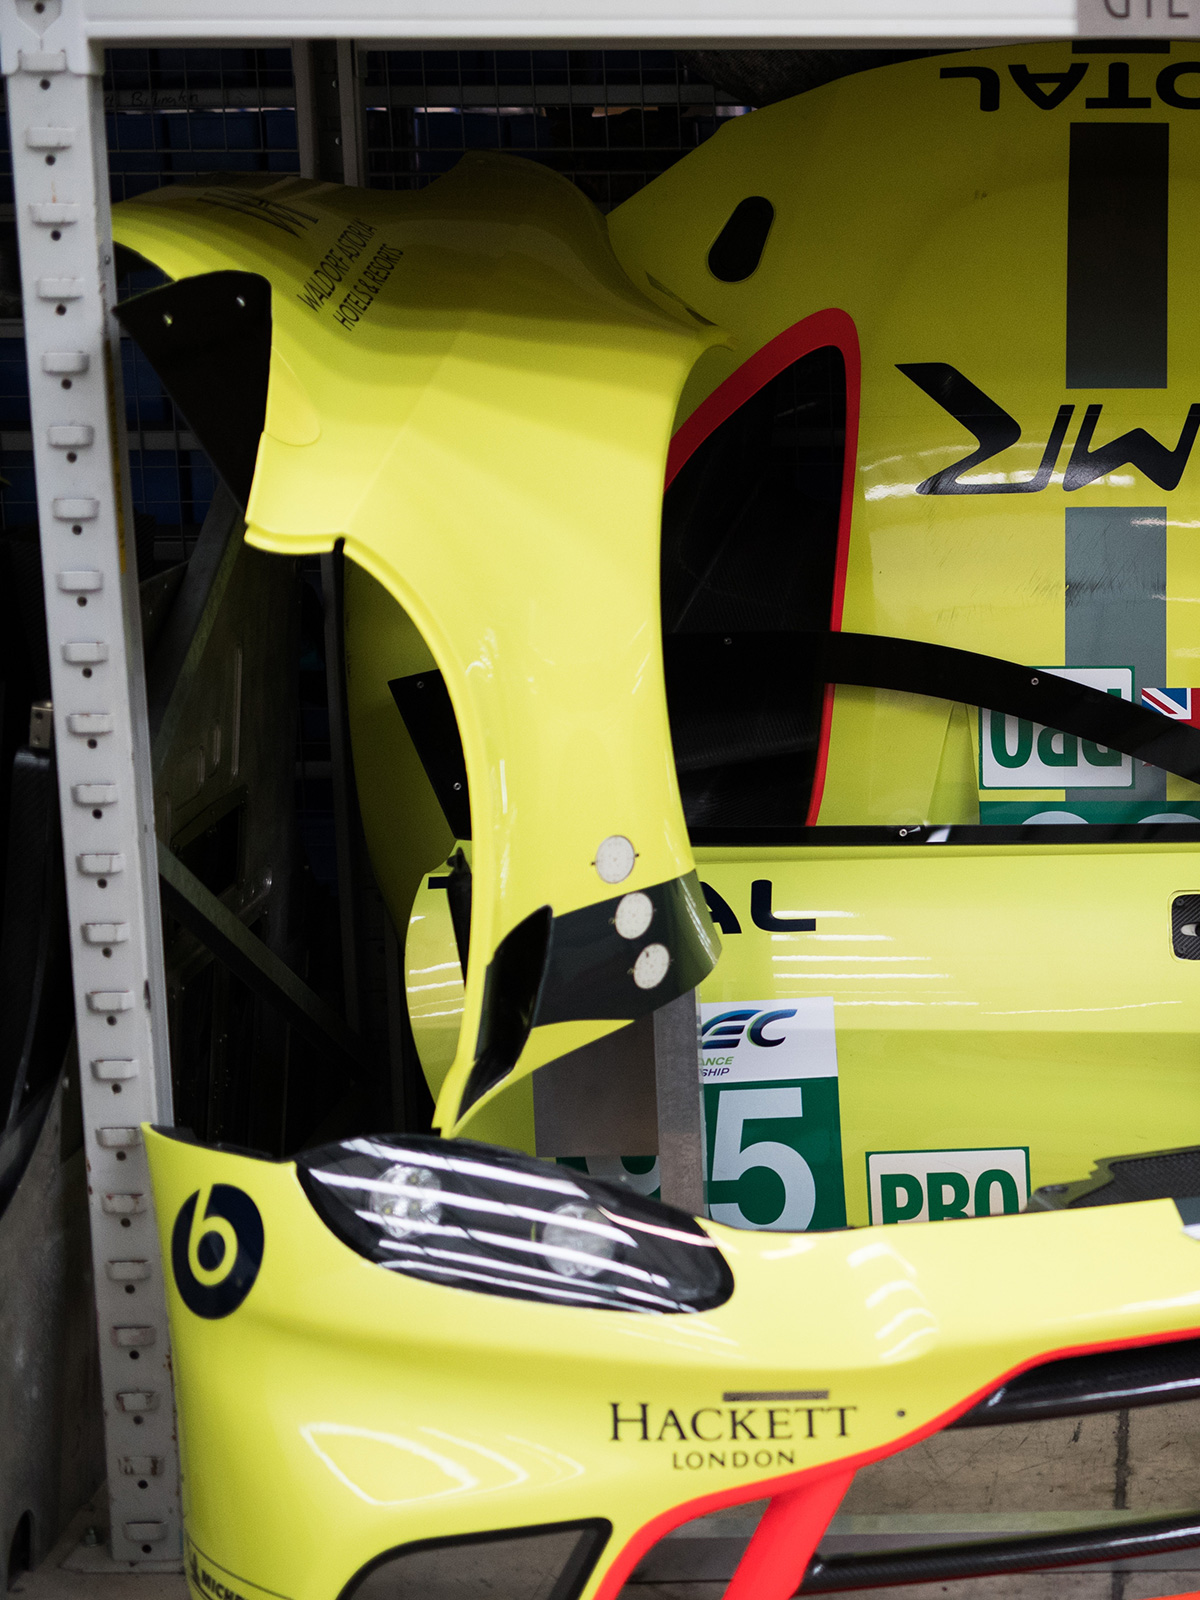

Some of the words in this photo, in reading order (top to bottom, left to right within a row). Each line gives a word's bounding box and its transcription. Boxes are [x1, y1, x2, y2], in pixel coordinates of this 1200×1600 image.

[297, 249, 350, 313] WALDORF
[335, 218, 378, 263] ASTORIA
[363, 243, 404, 286] RESORTS
[333, 284, 374, 331] HOTELS
[359, 279, 380, 295] &
[880, 1168, 1020, 1226] PRO
[609, 1402, 858, 1442] HACKETT
[672, 1450, 795, 1470] LONDON
